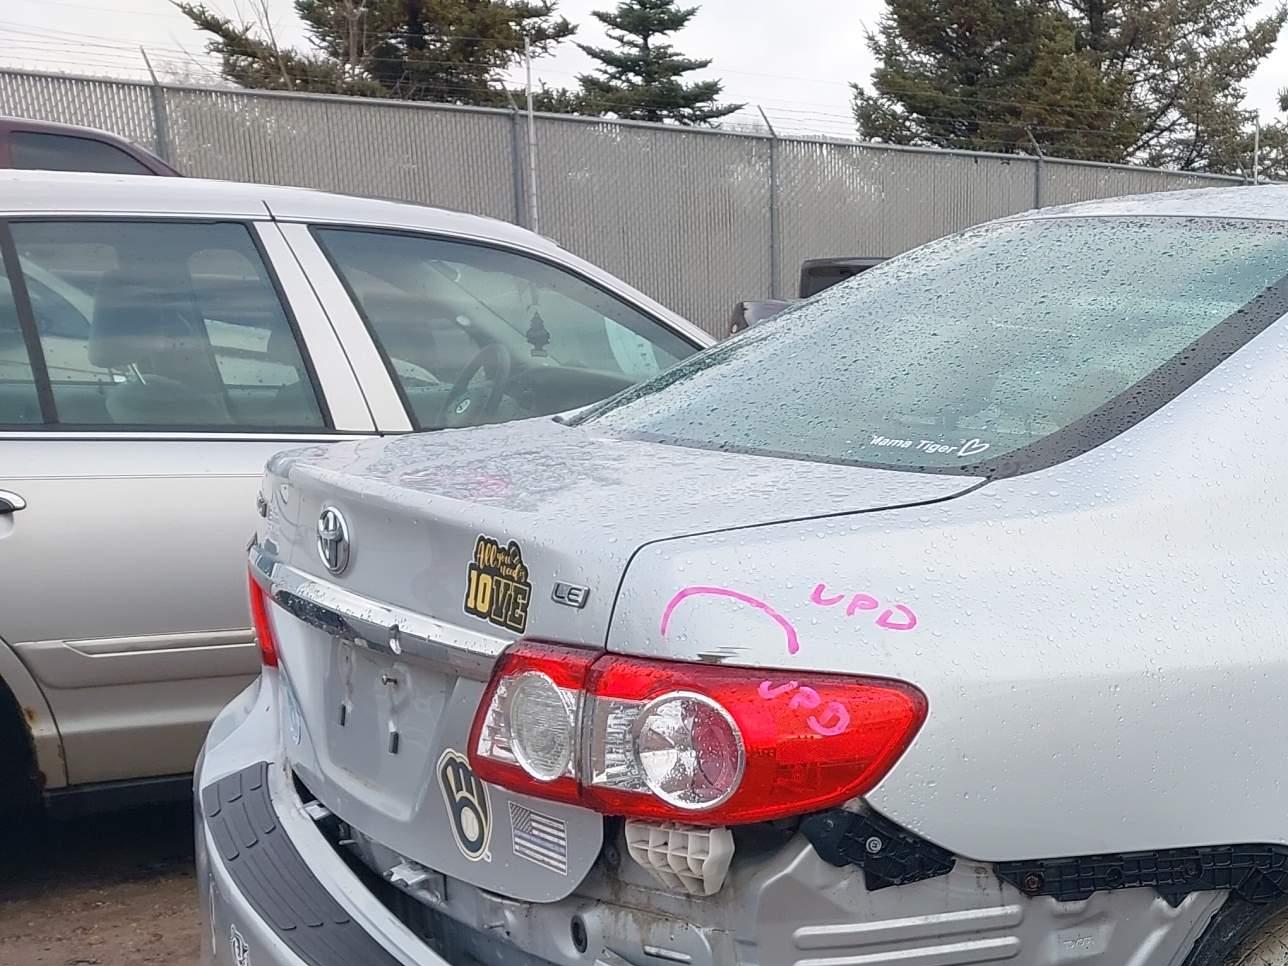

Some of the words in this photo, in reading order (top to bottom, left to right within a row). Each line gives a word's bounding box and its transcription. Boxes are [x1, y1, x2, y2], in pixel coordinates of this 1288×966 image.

[916, 440, 958, 453] Tiger
[476, 541, 497, 569] All
[554, 582, 583, 604] LE
[810, 583, 917, 630] UPD
[757, 681, 850, 736] UPD
